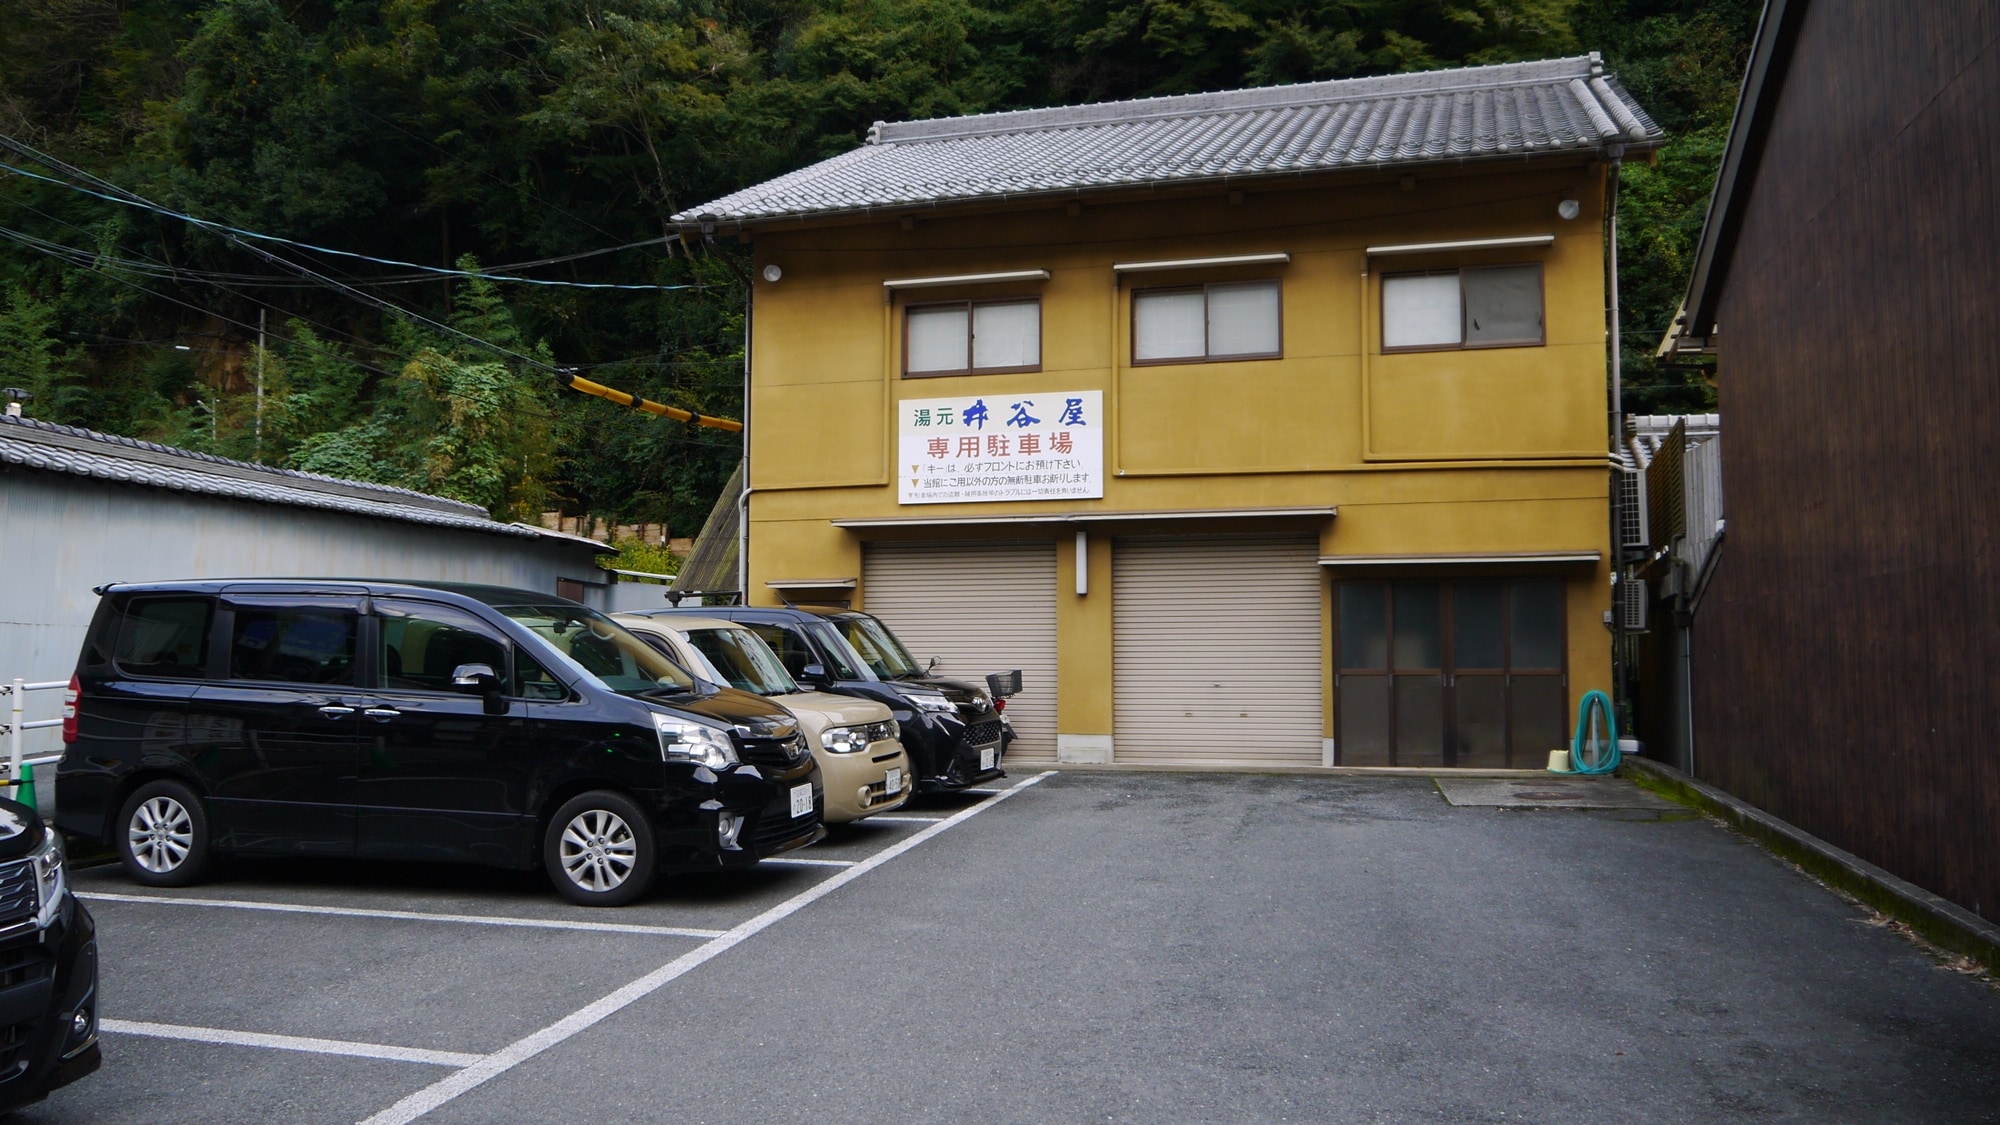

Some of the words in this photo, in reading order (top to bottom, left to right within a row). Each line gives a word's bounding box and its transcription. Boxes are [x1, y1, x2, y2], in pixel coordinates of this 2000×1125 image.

[913, 407, 954, 428] 湯元
[962, 398, 1087, 431] 井谷屋
[927, 431, 1073, 460] 専用駐車場
